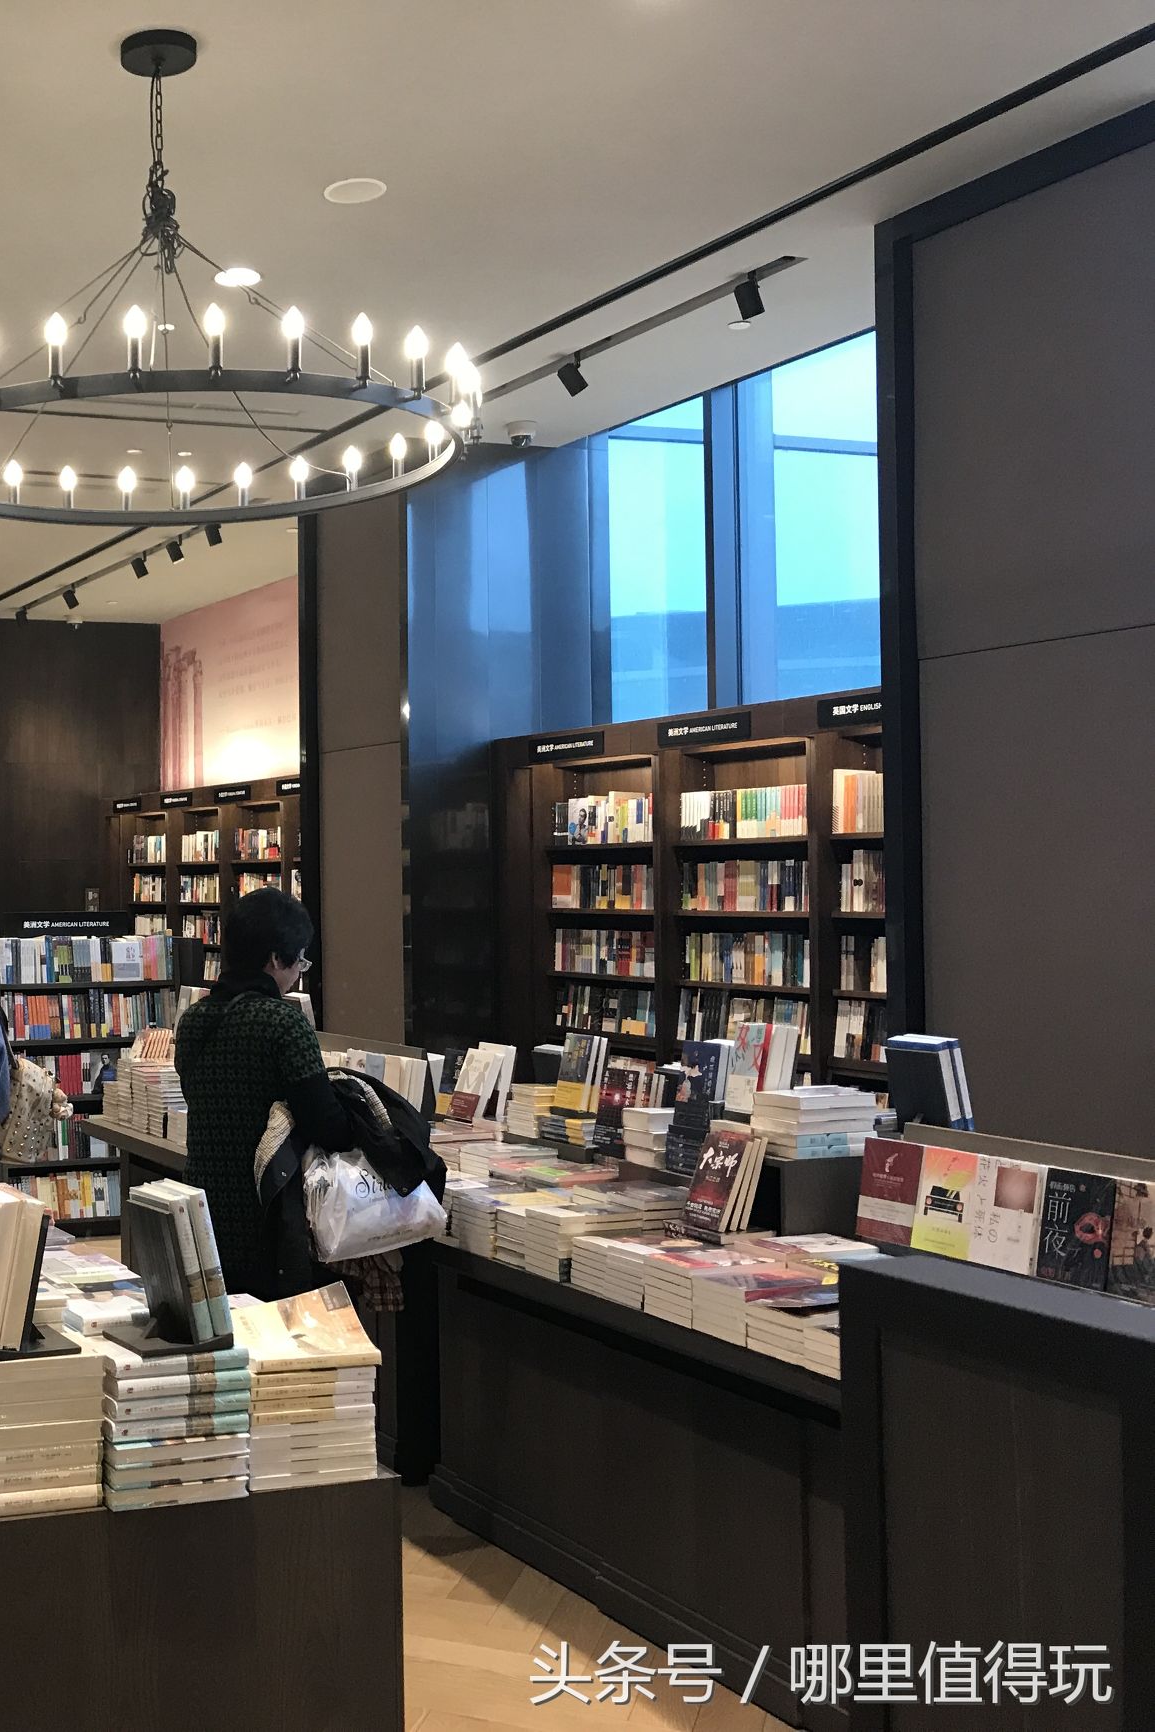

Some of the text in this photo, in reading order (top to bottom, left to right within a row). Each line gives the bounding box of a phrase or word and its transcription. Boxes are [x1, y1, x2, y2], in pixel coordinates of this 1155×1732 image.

[689, 725, 712, 734] AMERICAN
[712, 722, 738, 731] LITERATURE
[23, 920, 50, 929] 美洲文学
[699, 1146, 739, 1178] 大宗师
[1043, 1191, 1073, 1258] 前夜
